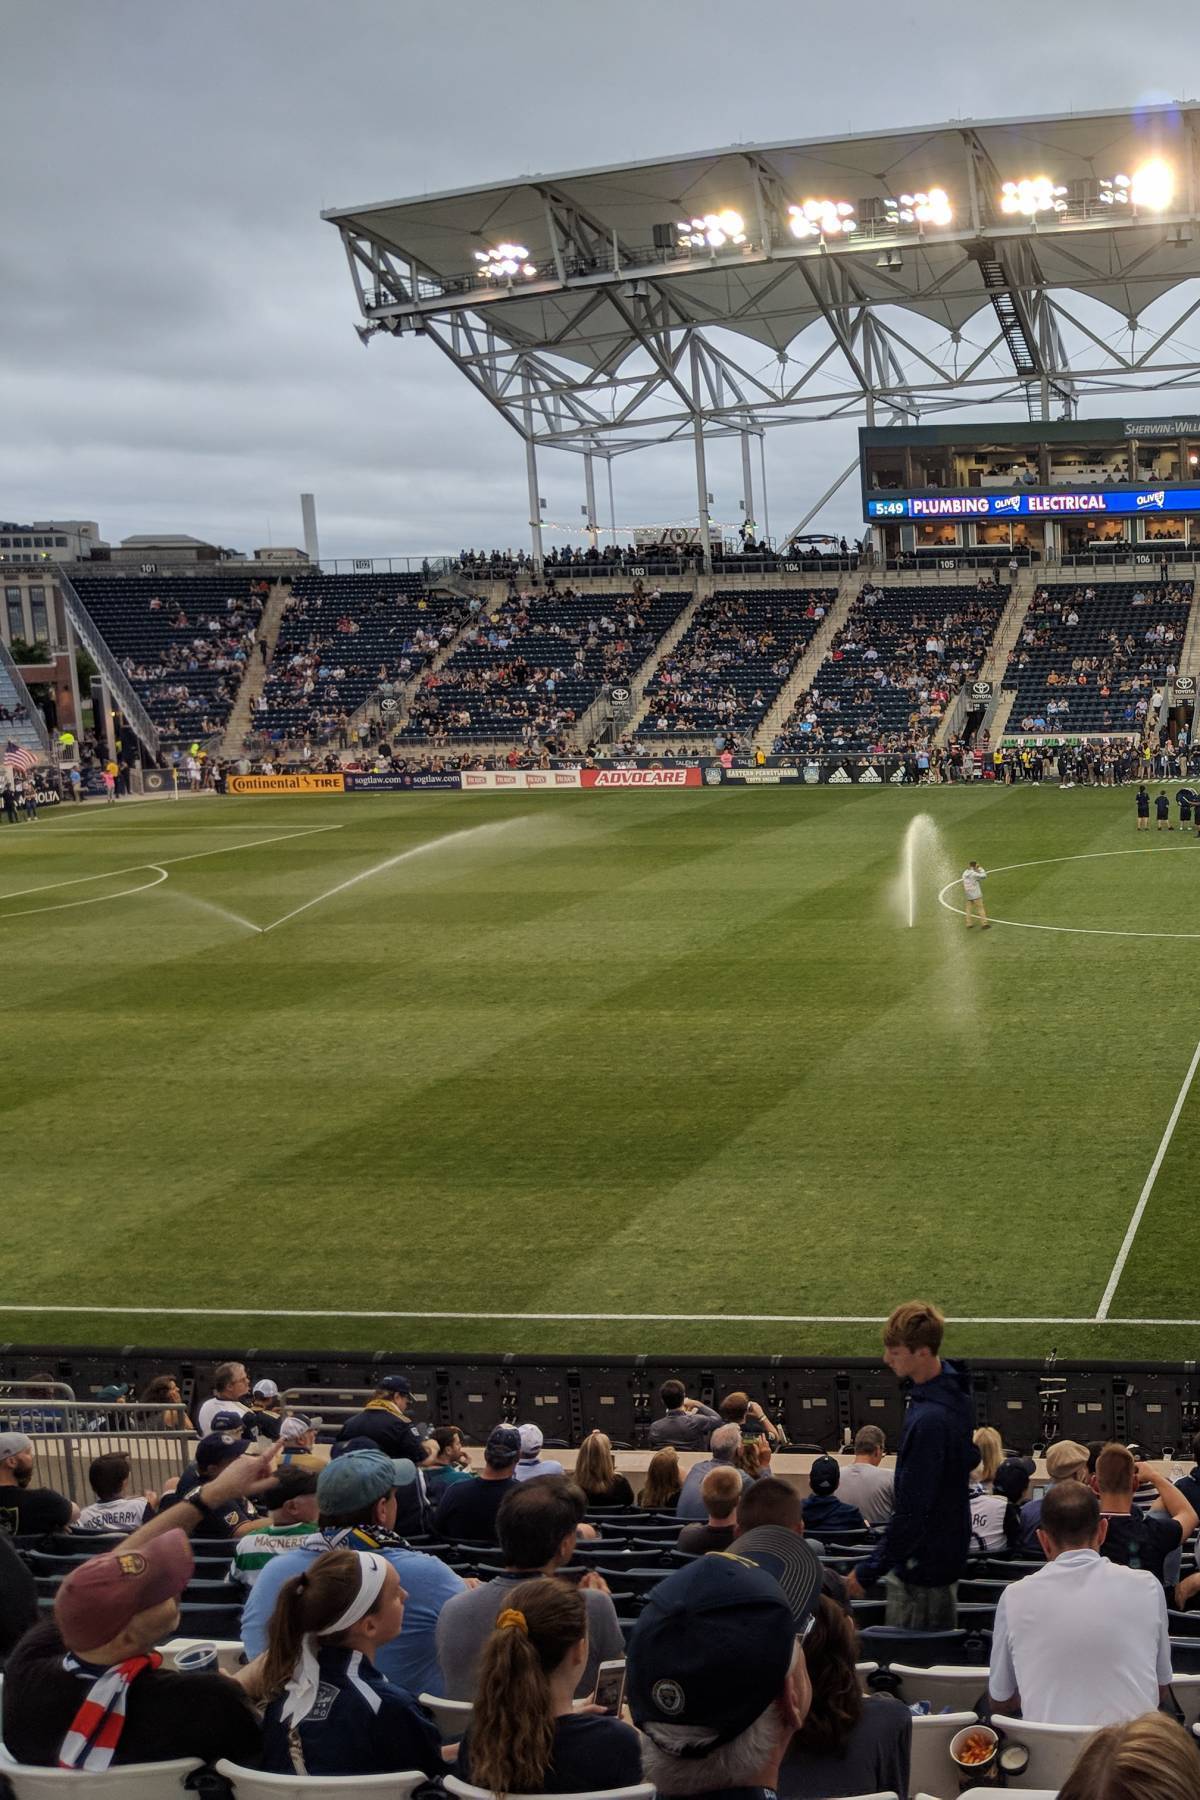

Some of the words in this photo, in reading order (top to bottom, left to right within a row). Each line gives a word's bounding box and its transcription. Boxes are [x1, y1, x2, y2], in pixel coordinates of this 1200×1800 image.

[876, 503, 904, 514] 5:49
[913, 498, 990, 514] PLUMBING
[994, 496, 1020, 511] OLIVER
[1028, 496, 1106, 510] ELECTRICAL
[1137, 491, 1165, 507] OLIVER
[1136, 555, 1150, 563] 106
[141, 564, 156, 572] 101
[785, 563, 799, 571] 104
[940, 560, 954, 568] 105
[631, 567, 645, 576] 103
[355, 774, 401, 785] sogtlaw.com
[413, 774, 460, 784] sogtlaw.com
[597, 771, 686, 785] ADVOCARE
[232, 775, 300, 792] Continental
[315, 778, 340, 788] TIRE
